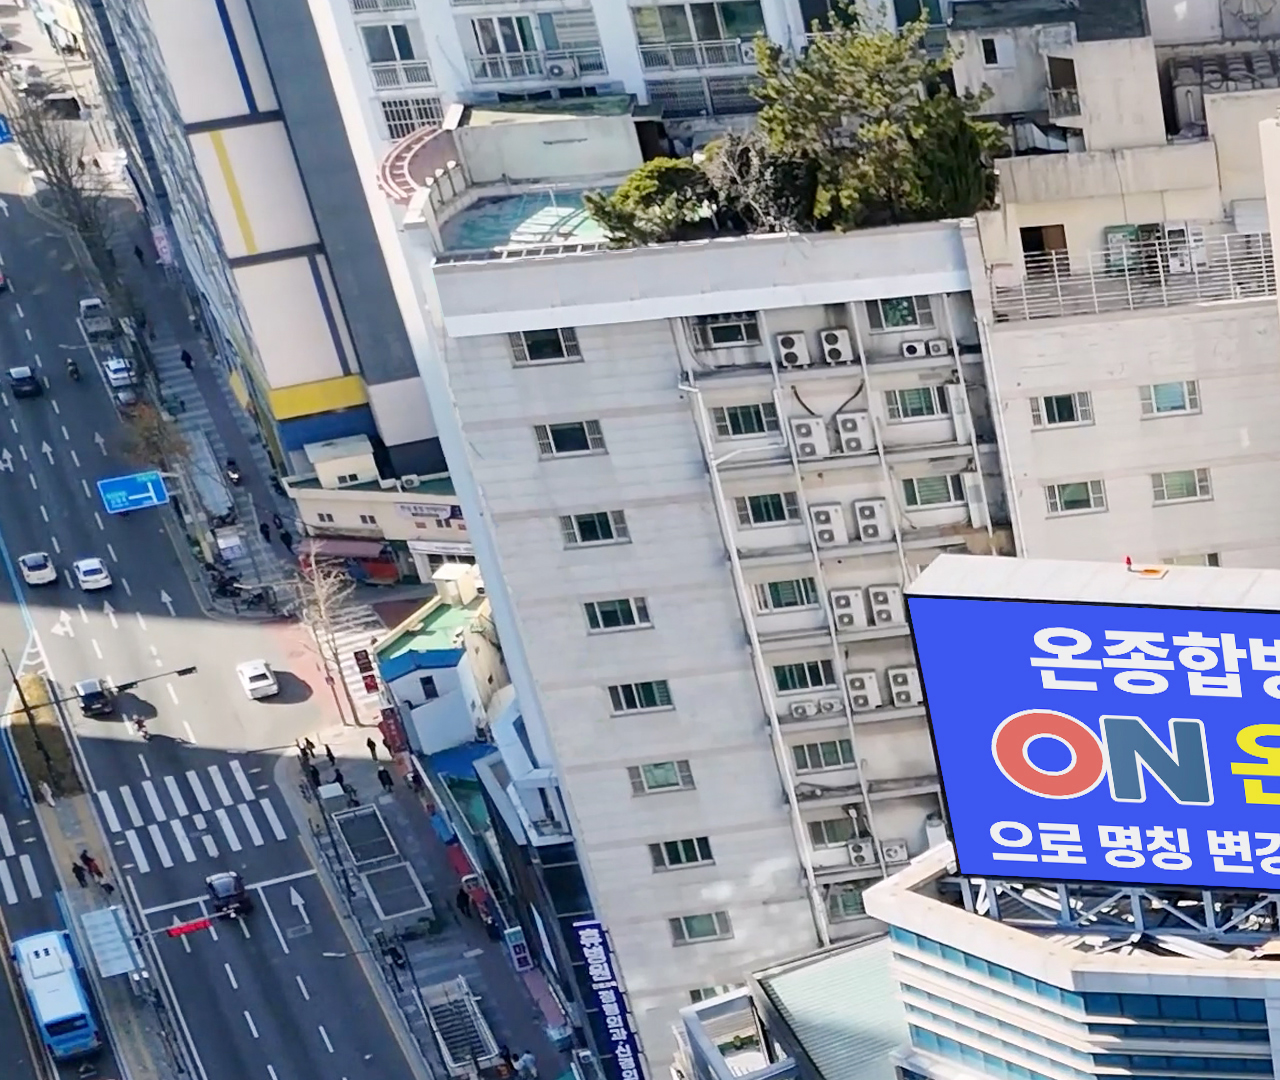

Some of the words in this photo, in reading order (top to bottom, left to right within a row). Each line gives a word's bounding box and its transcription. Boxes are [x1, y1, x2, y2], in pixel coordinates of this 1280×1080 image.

[991, 708, 1214, 806] ON
[990, 821, 1087, 866] 으로
[1098, 825, 1193, 872] 명칭
